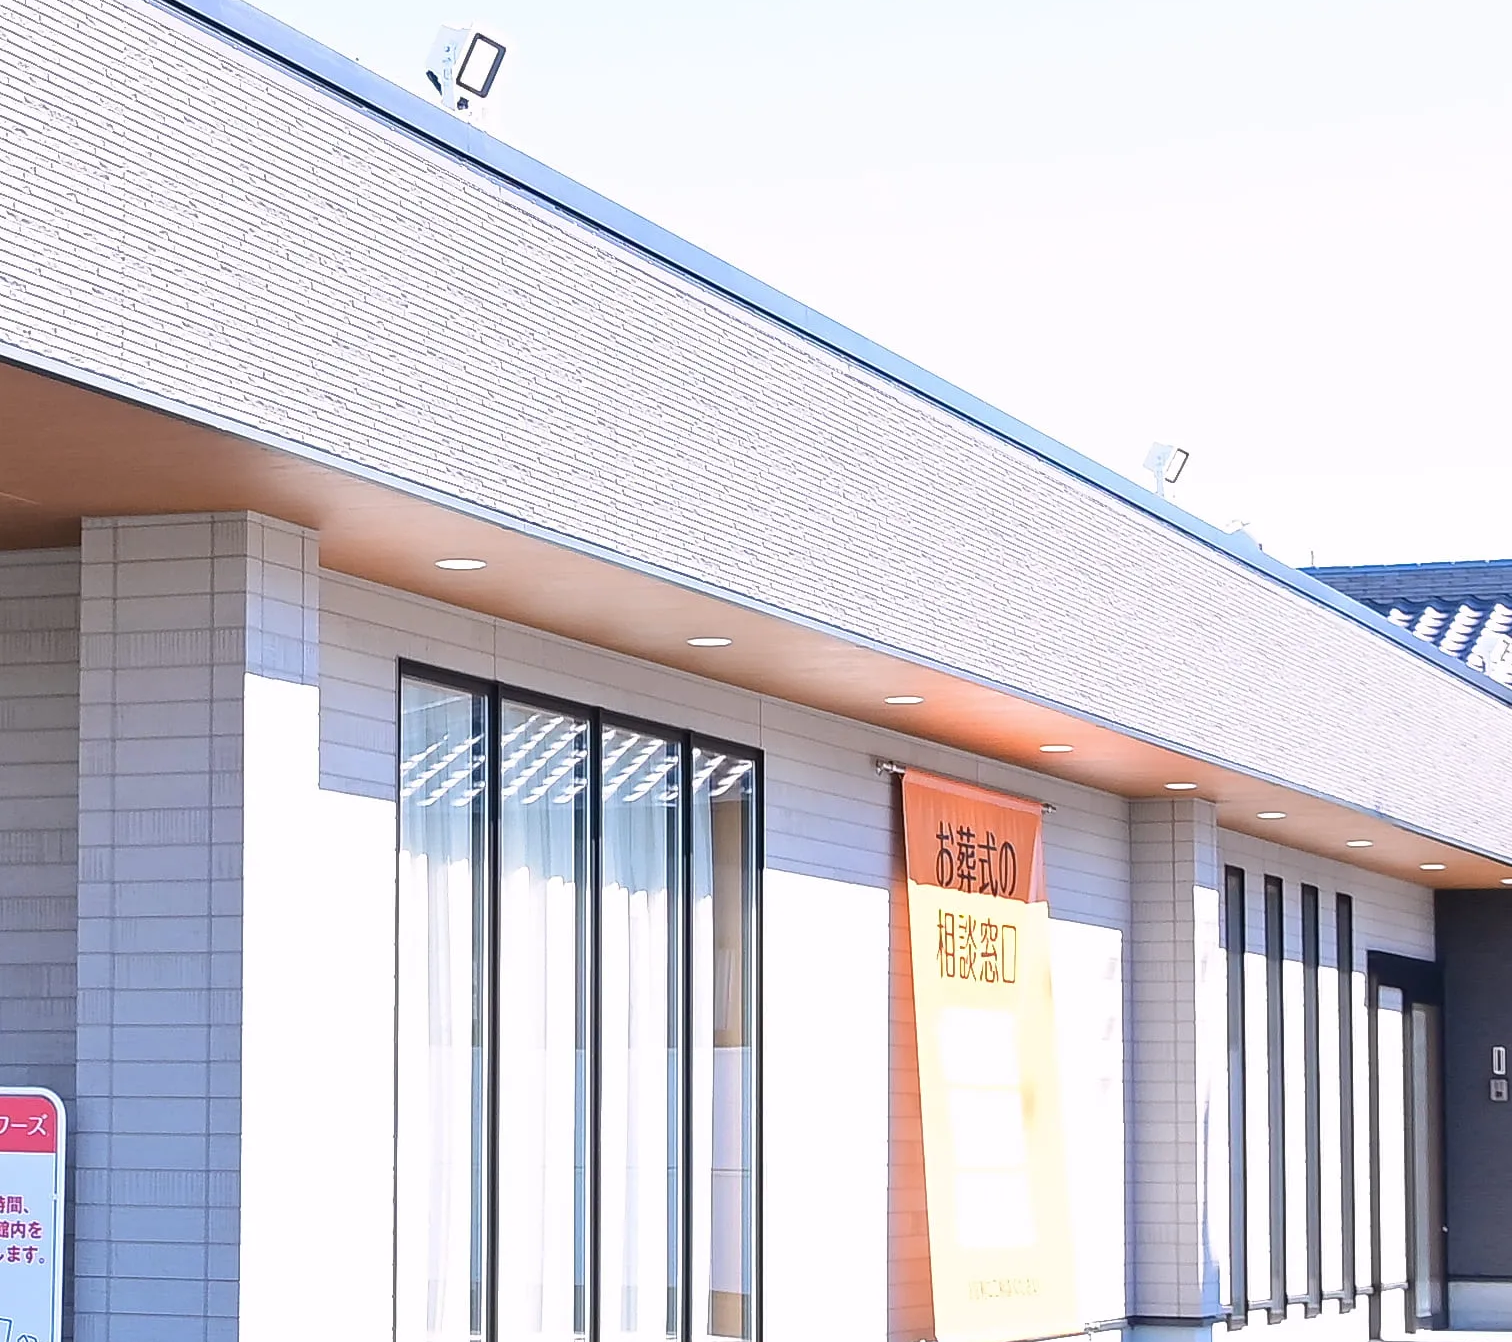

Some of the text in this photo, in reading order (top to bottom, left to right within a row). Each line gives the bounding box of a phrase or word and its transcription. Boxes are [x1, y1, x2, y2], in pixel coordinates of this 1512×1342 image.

[935, 820, 1017, 897] お葬式の
[936, 908, 1017, 983] 相談窓口
